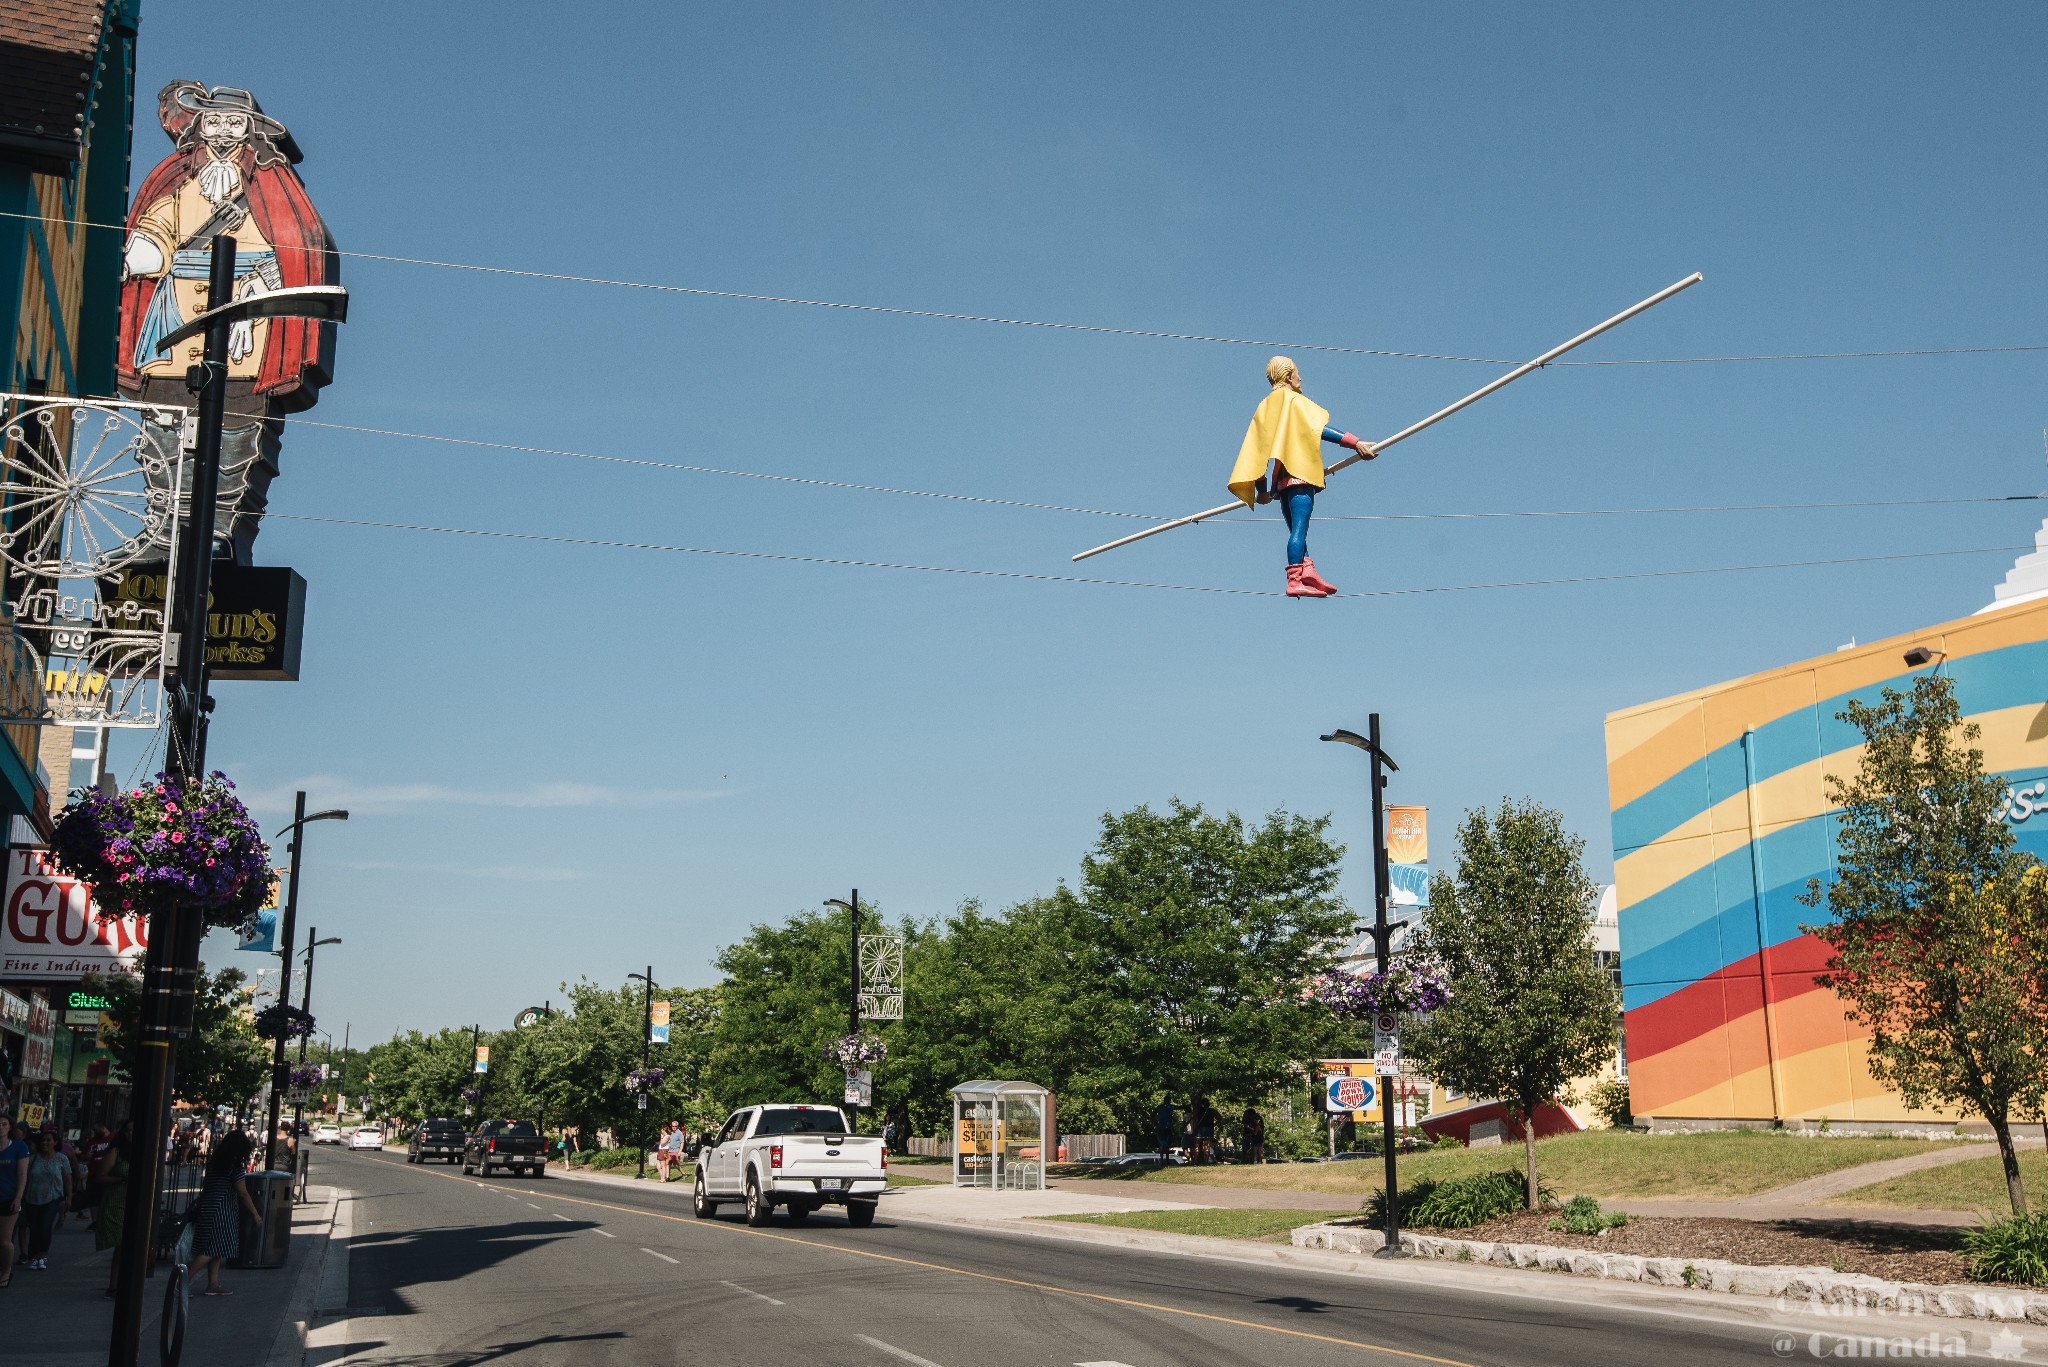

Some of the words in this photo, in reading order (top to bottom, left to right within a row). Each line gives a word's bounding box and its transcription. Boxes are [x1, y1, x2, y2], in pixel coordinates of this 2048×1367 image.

[8, 880, 149, 955] GUR
[4, 959, 39, 971] Fine
[46, 960, 101, 972] Indian
[1341, 1088, 1362, 1096] DOWN
